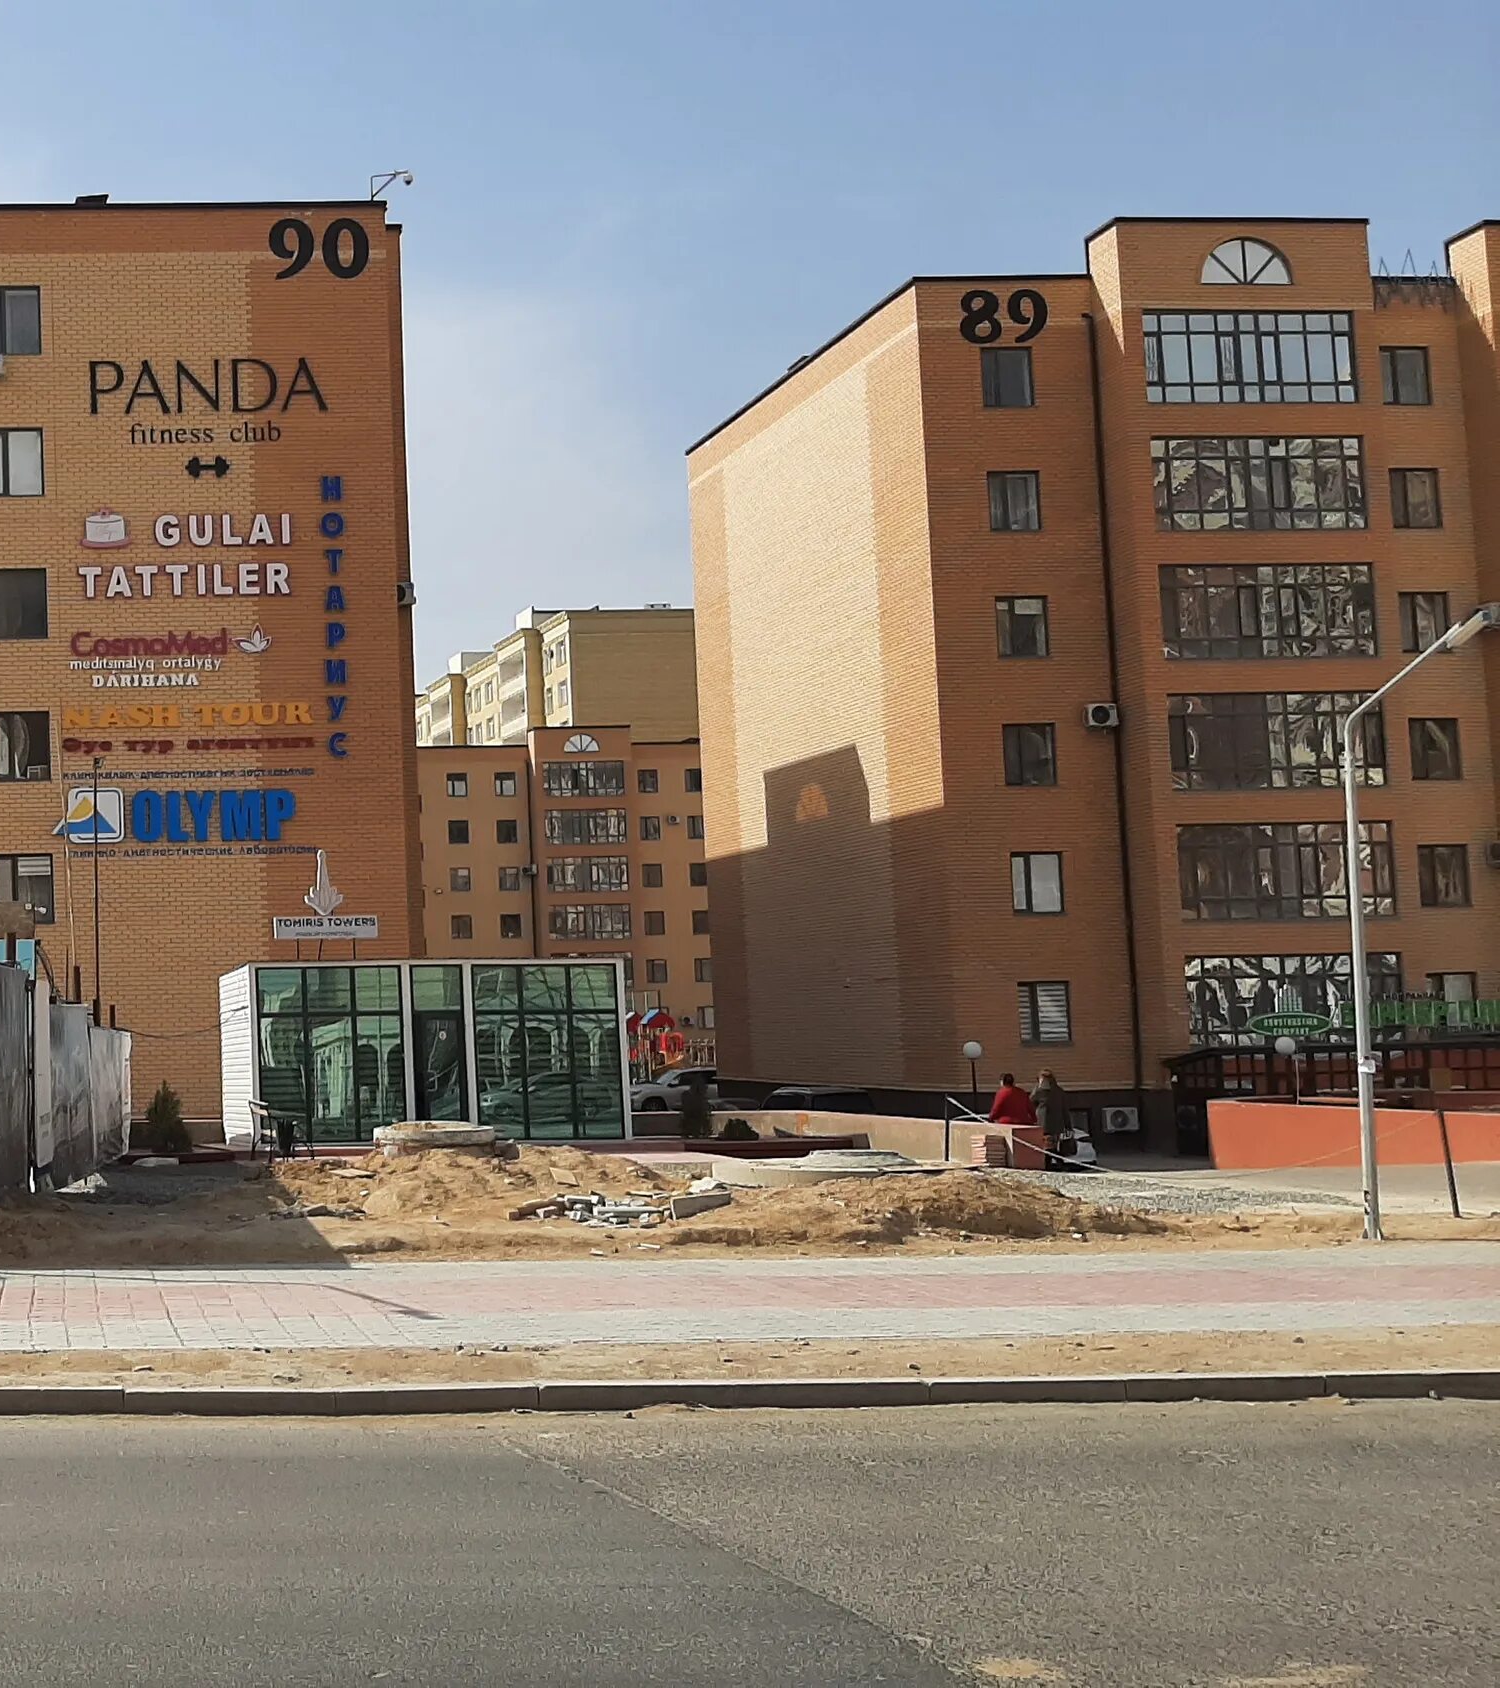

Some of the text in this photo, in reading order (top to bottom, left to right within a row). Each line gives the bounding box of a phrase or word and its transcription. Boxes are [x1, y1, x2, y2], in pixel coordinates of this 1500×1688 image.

[268, 217, 370, 280] 90
[958, 288, 1048, 344] 89
[88, 357, 329, 415] PANDA
[129, 420, 282, 445] fitness club
[154, 512, 292, 547] GULAI
[77, 562, 291, 599] TATTILER
[70, 627, 228, 657] CosmoMed
[62, 702, 314, 729] NASH TOUR
[131, 788, 296, 843] OLYMP
[277, 917, 376, 928] TOMIRIS TOWERS
